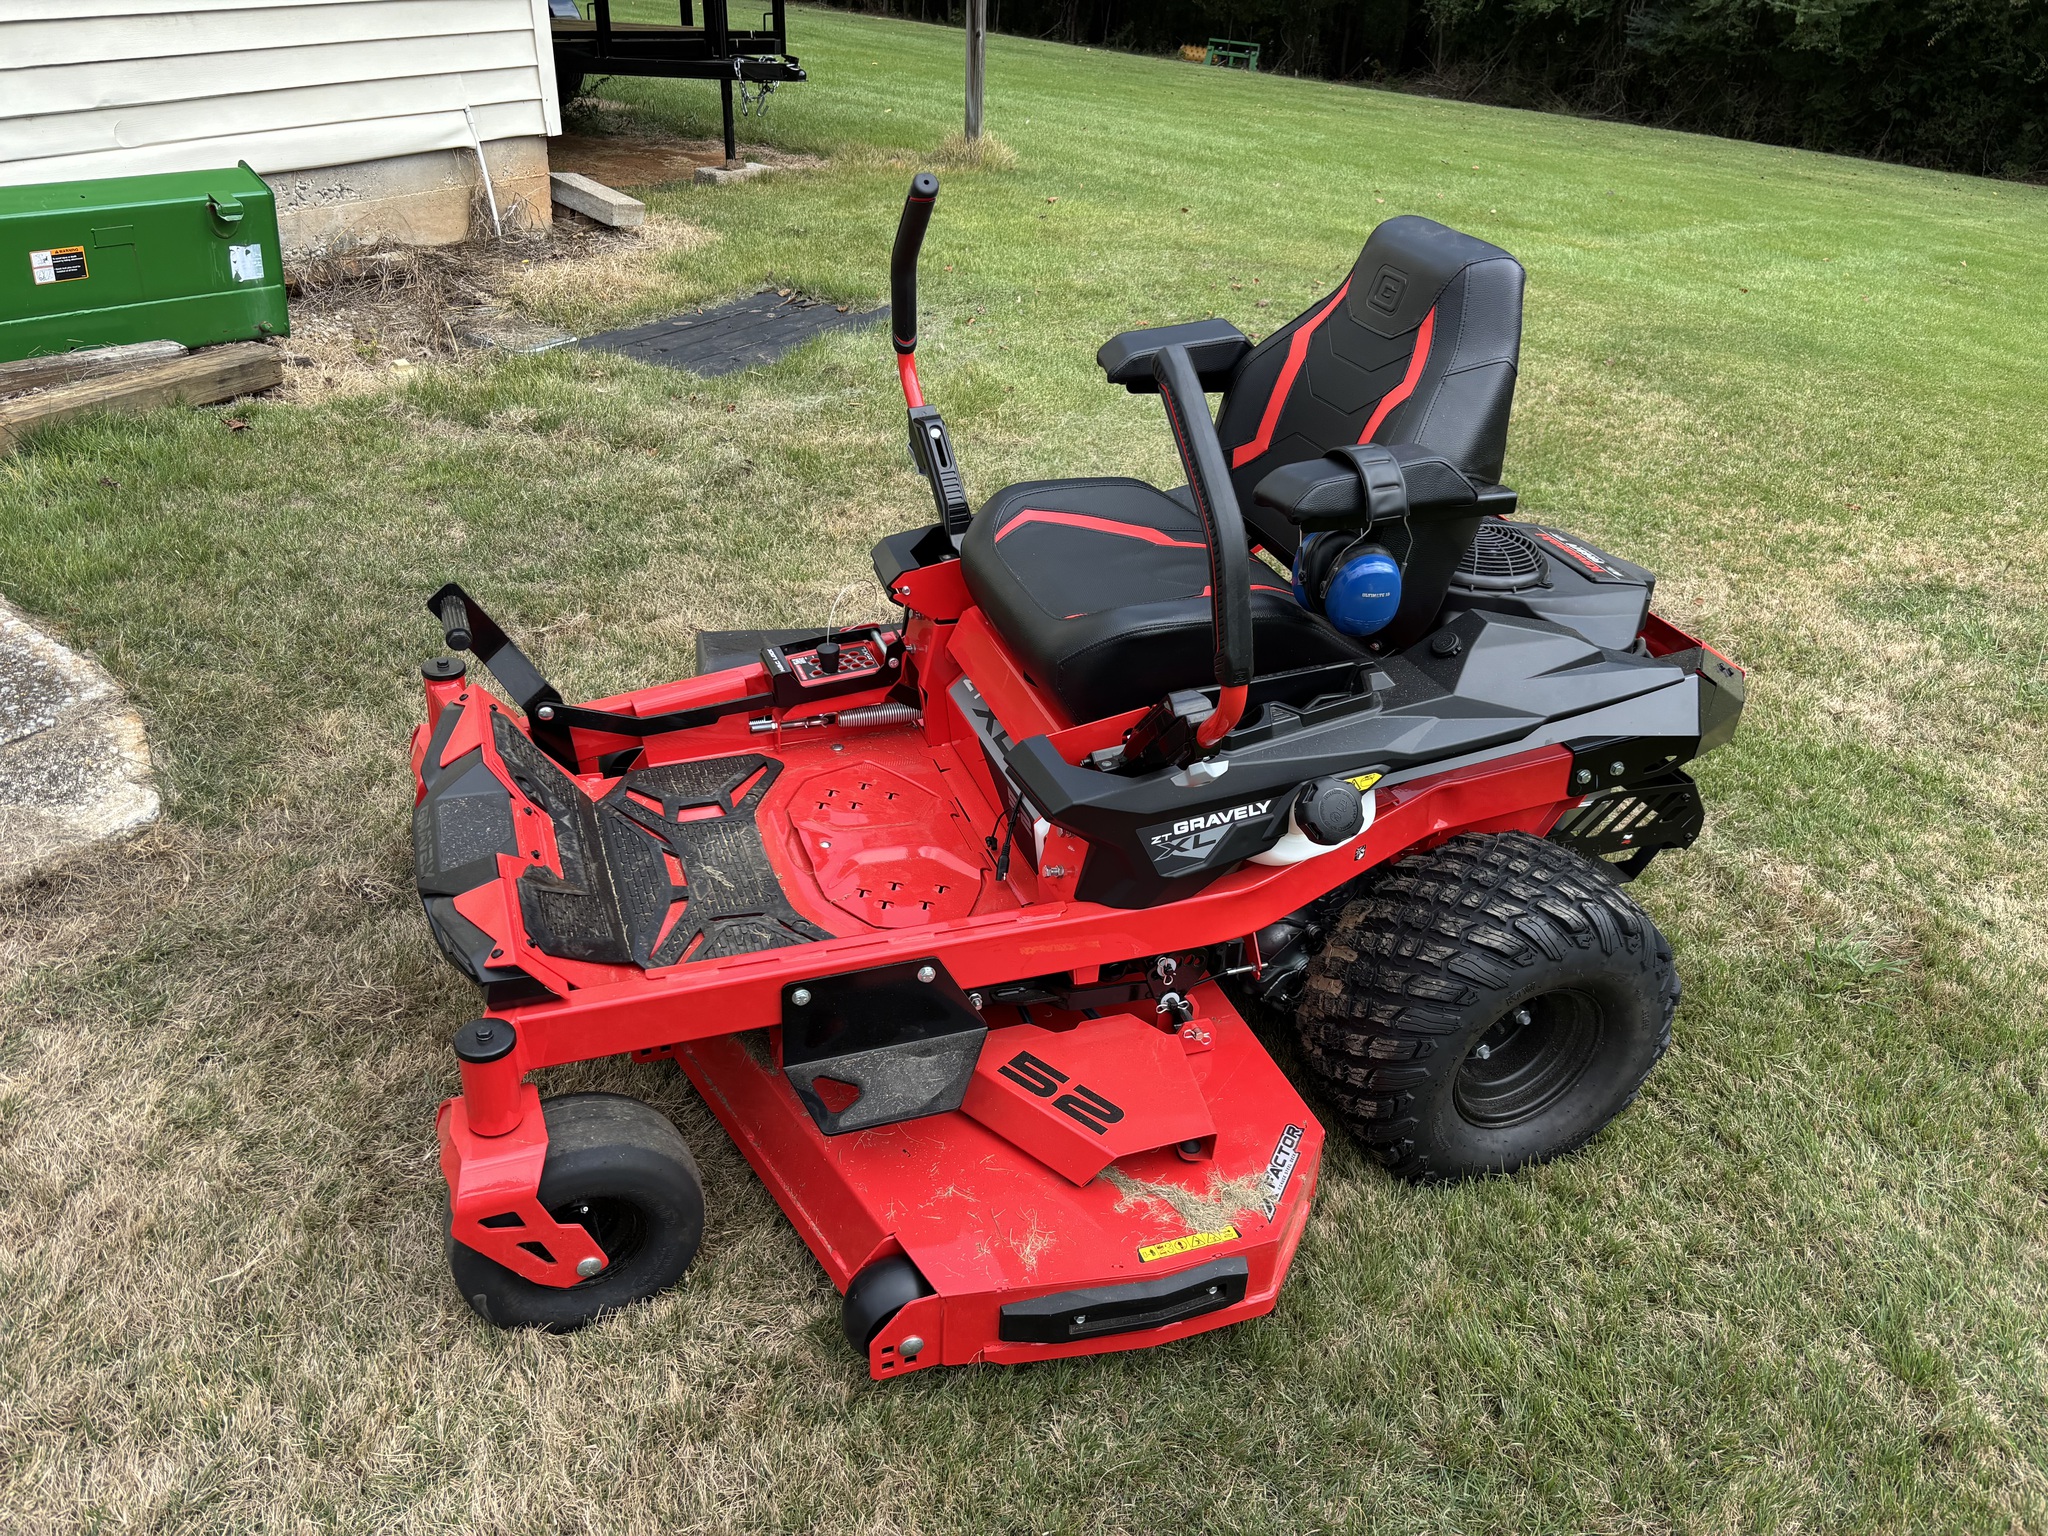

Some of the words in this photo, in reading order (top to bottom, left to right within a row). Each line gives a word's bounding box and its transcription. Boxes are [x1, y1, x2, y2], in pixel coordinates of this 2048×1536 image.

[417, 804, 435, 877] GRAVELY
[1150, 832, 1173, 845] ZT
[1173, 799, 1272, 836] GRAVELY
[1154, 834, 1217, 861] XL
[996, 1050, 1125, 1136] 52
